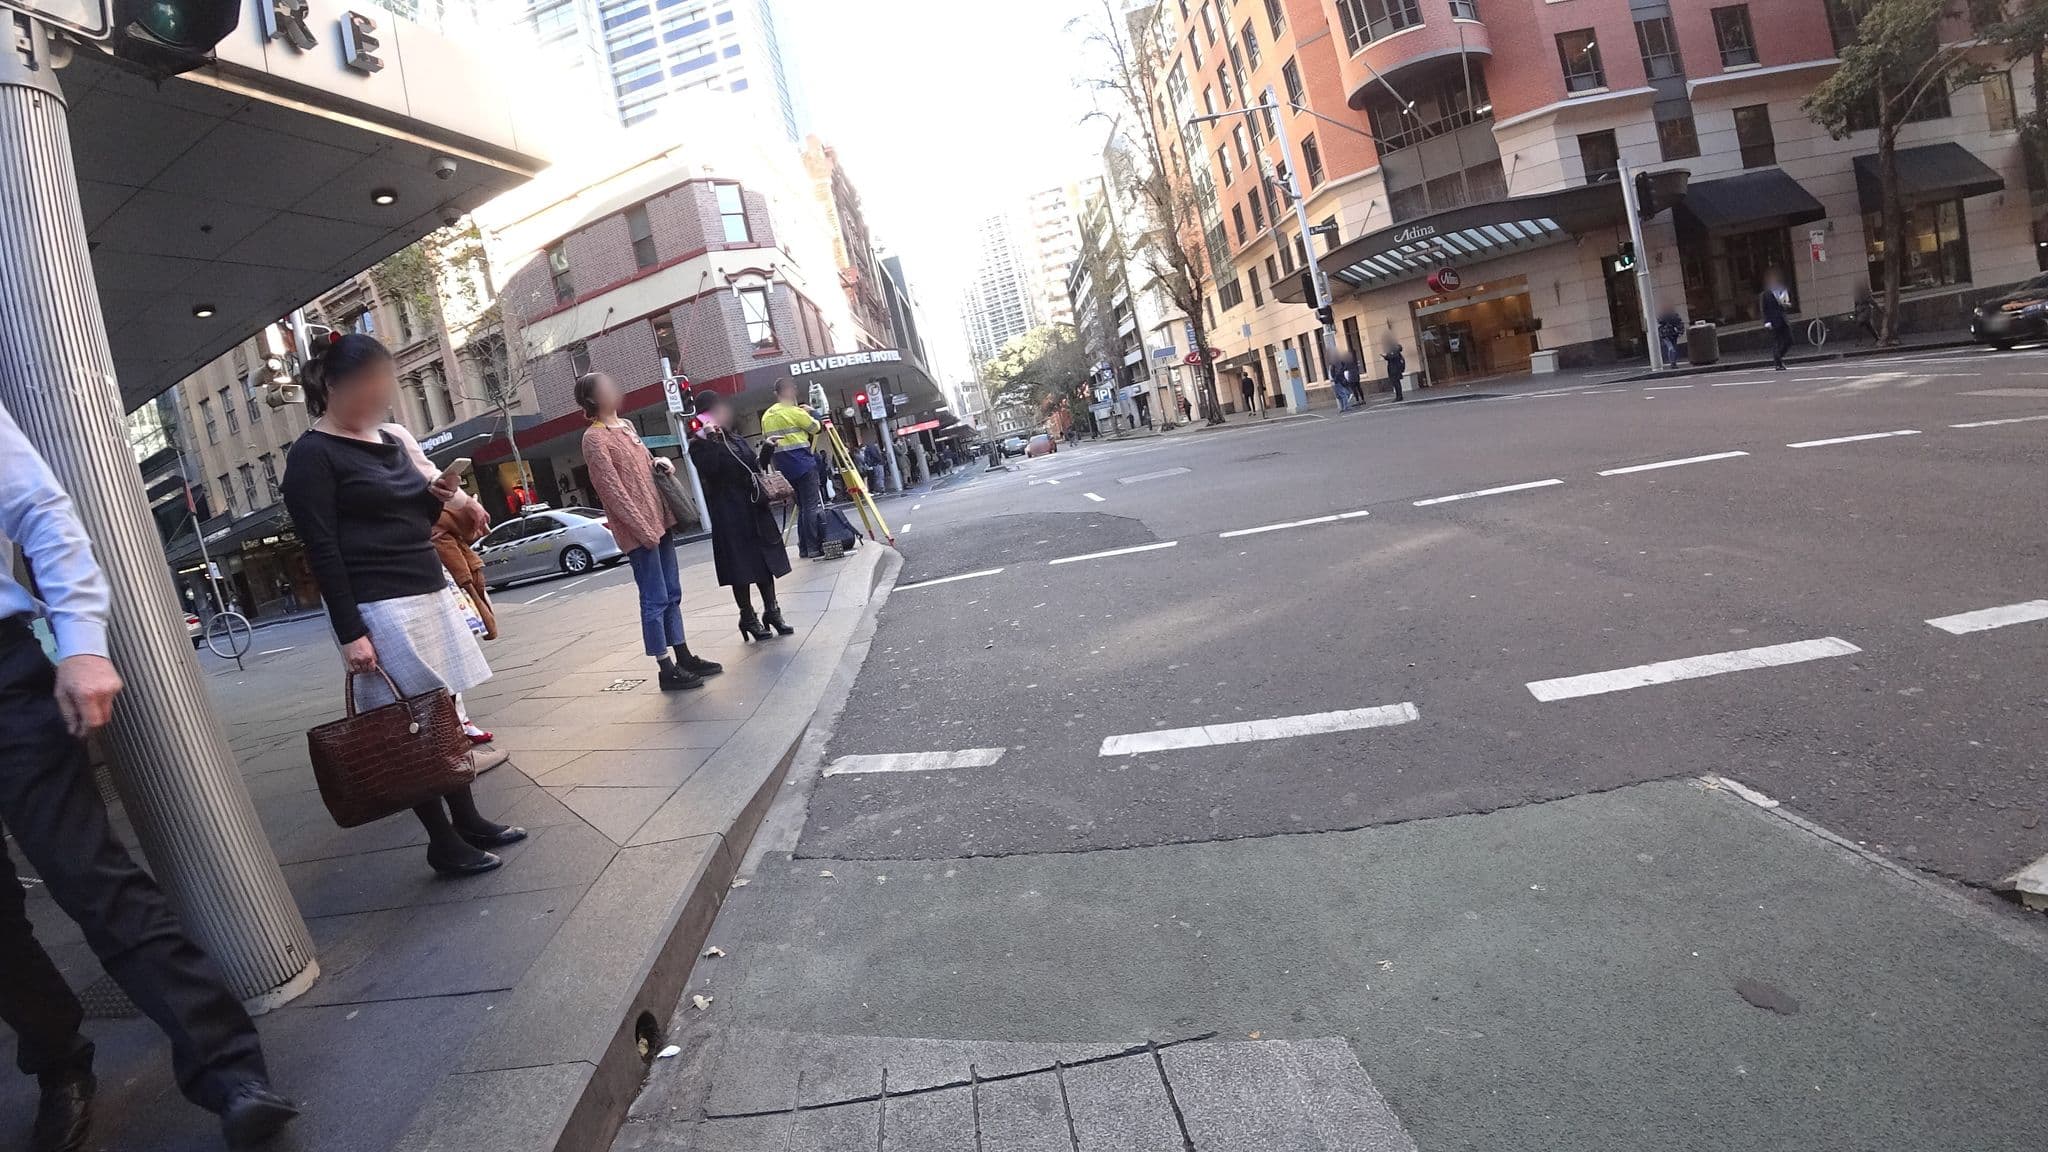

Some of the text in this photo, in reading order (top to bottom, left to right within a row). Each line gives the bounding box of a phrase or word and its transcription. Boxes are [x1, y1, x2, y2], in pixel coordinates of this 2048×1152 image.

[1394, 225, 1435, 243] Adina
[790, 350, 901, 376] BELVEDERE HOTEL
